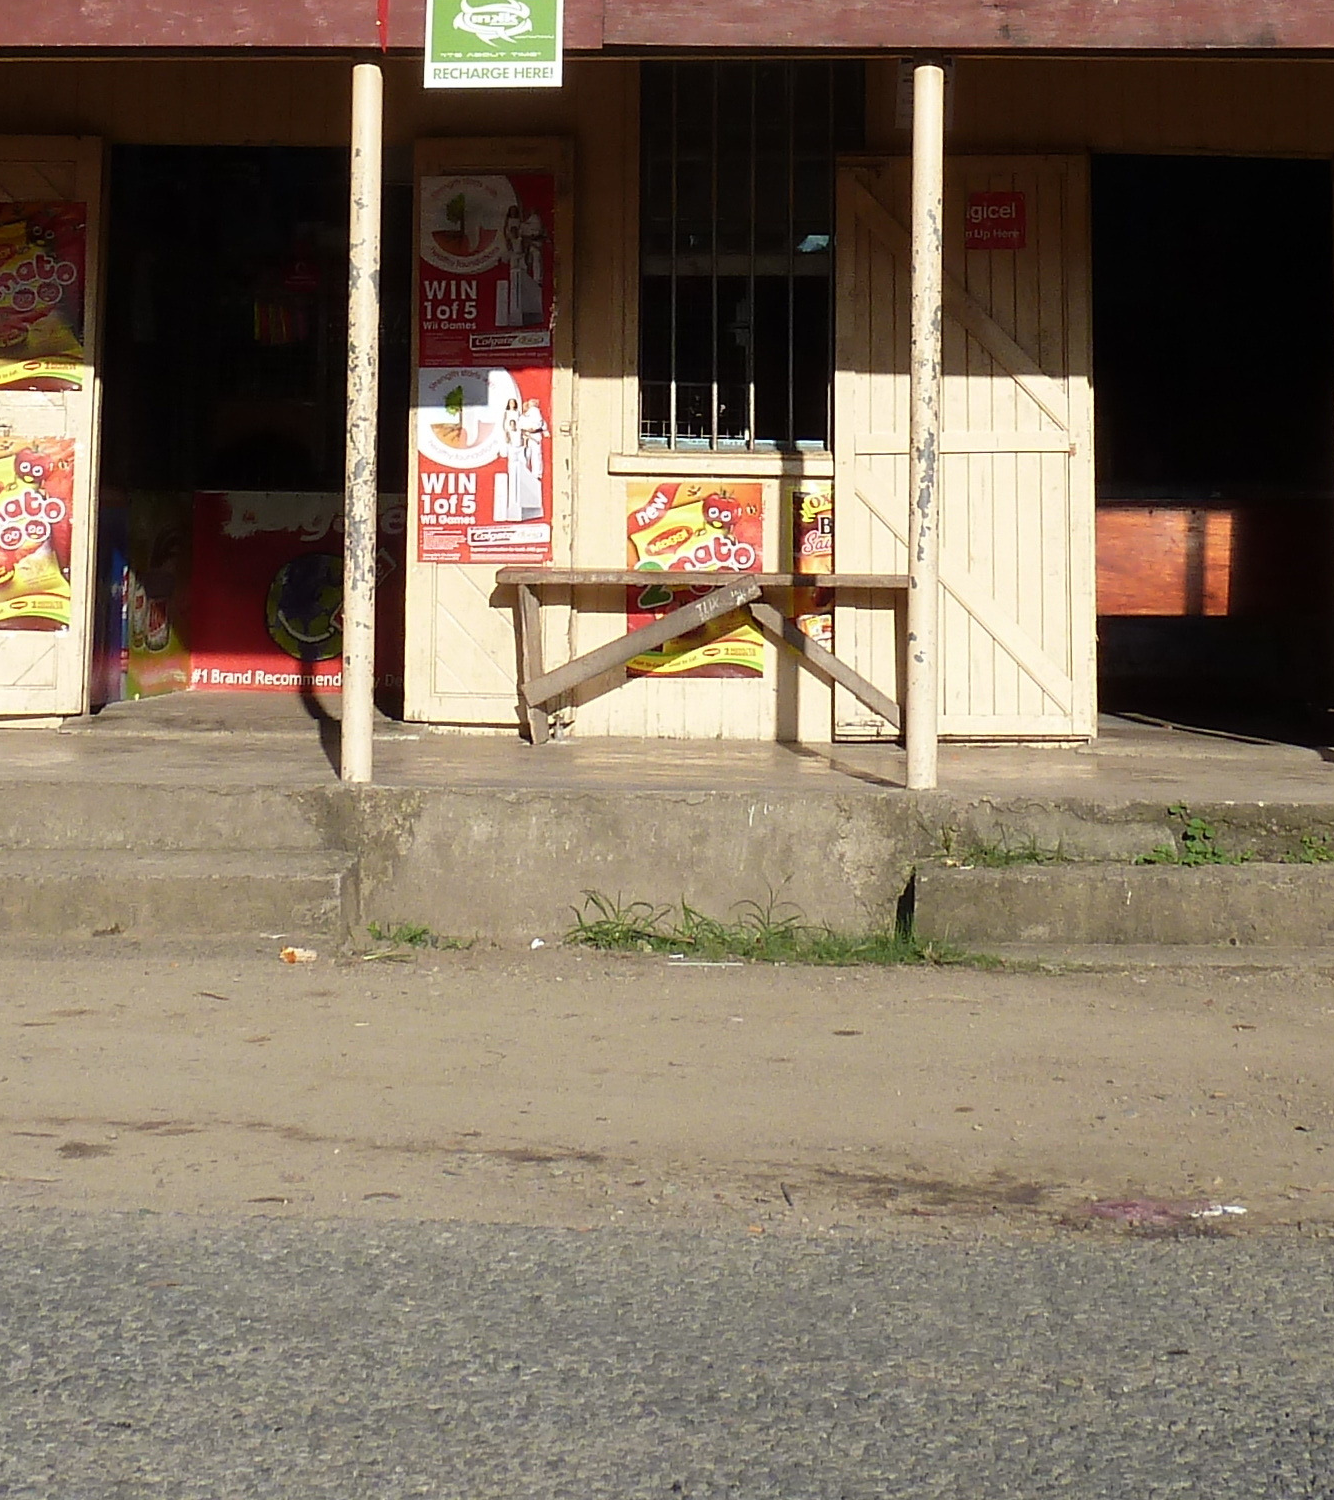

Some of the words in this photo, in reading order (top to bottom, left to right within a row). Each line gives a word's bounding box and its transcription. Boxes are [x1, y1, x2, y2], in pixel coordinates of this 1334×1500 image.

[433, 68, 510, 79] RECHARGE
[514, 67, 554, 78] HERE!
[974, 229, 990, 240] Up
[424, 280, 477, 300] WIN
[423, 322, 439, 330] Wii
[441, 322, 477, 331] Games
[421, 473, 477, 494] WIN
[636, 491, 669, 526] new
[420, 515, 437, 524] Wii
[438, 515, 476, 524] Games
[649, 529, 688, 553] Maggi
[191, 669, 208, 682] #1
[212, 669, 252, 684] Brand
